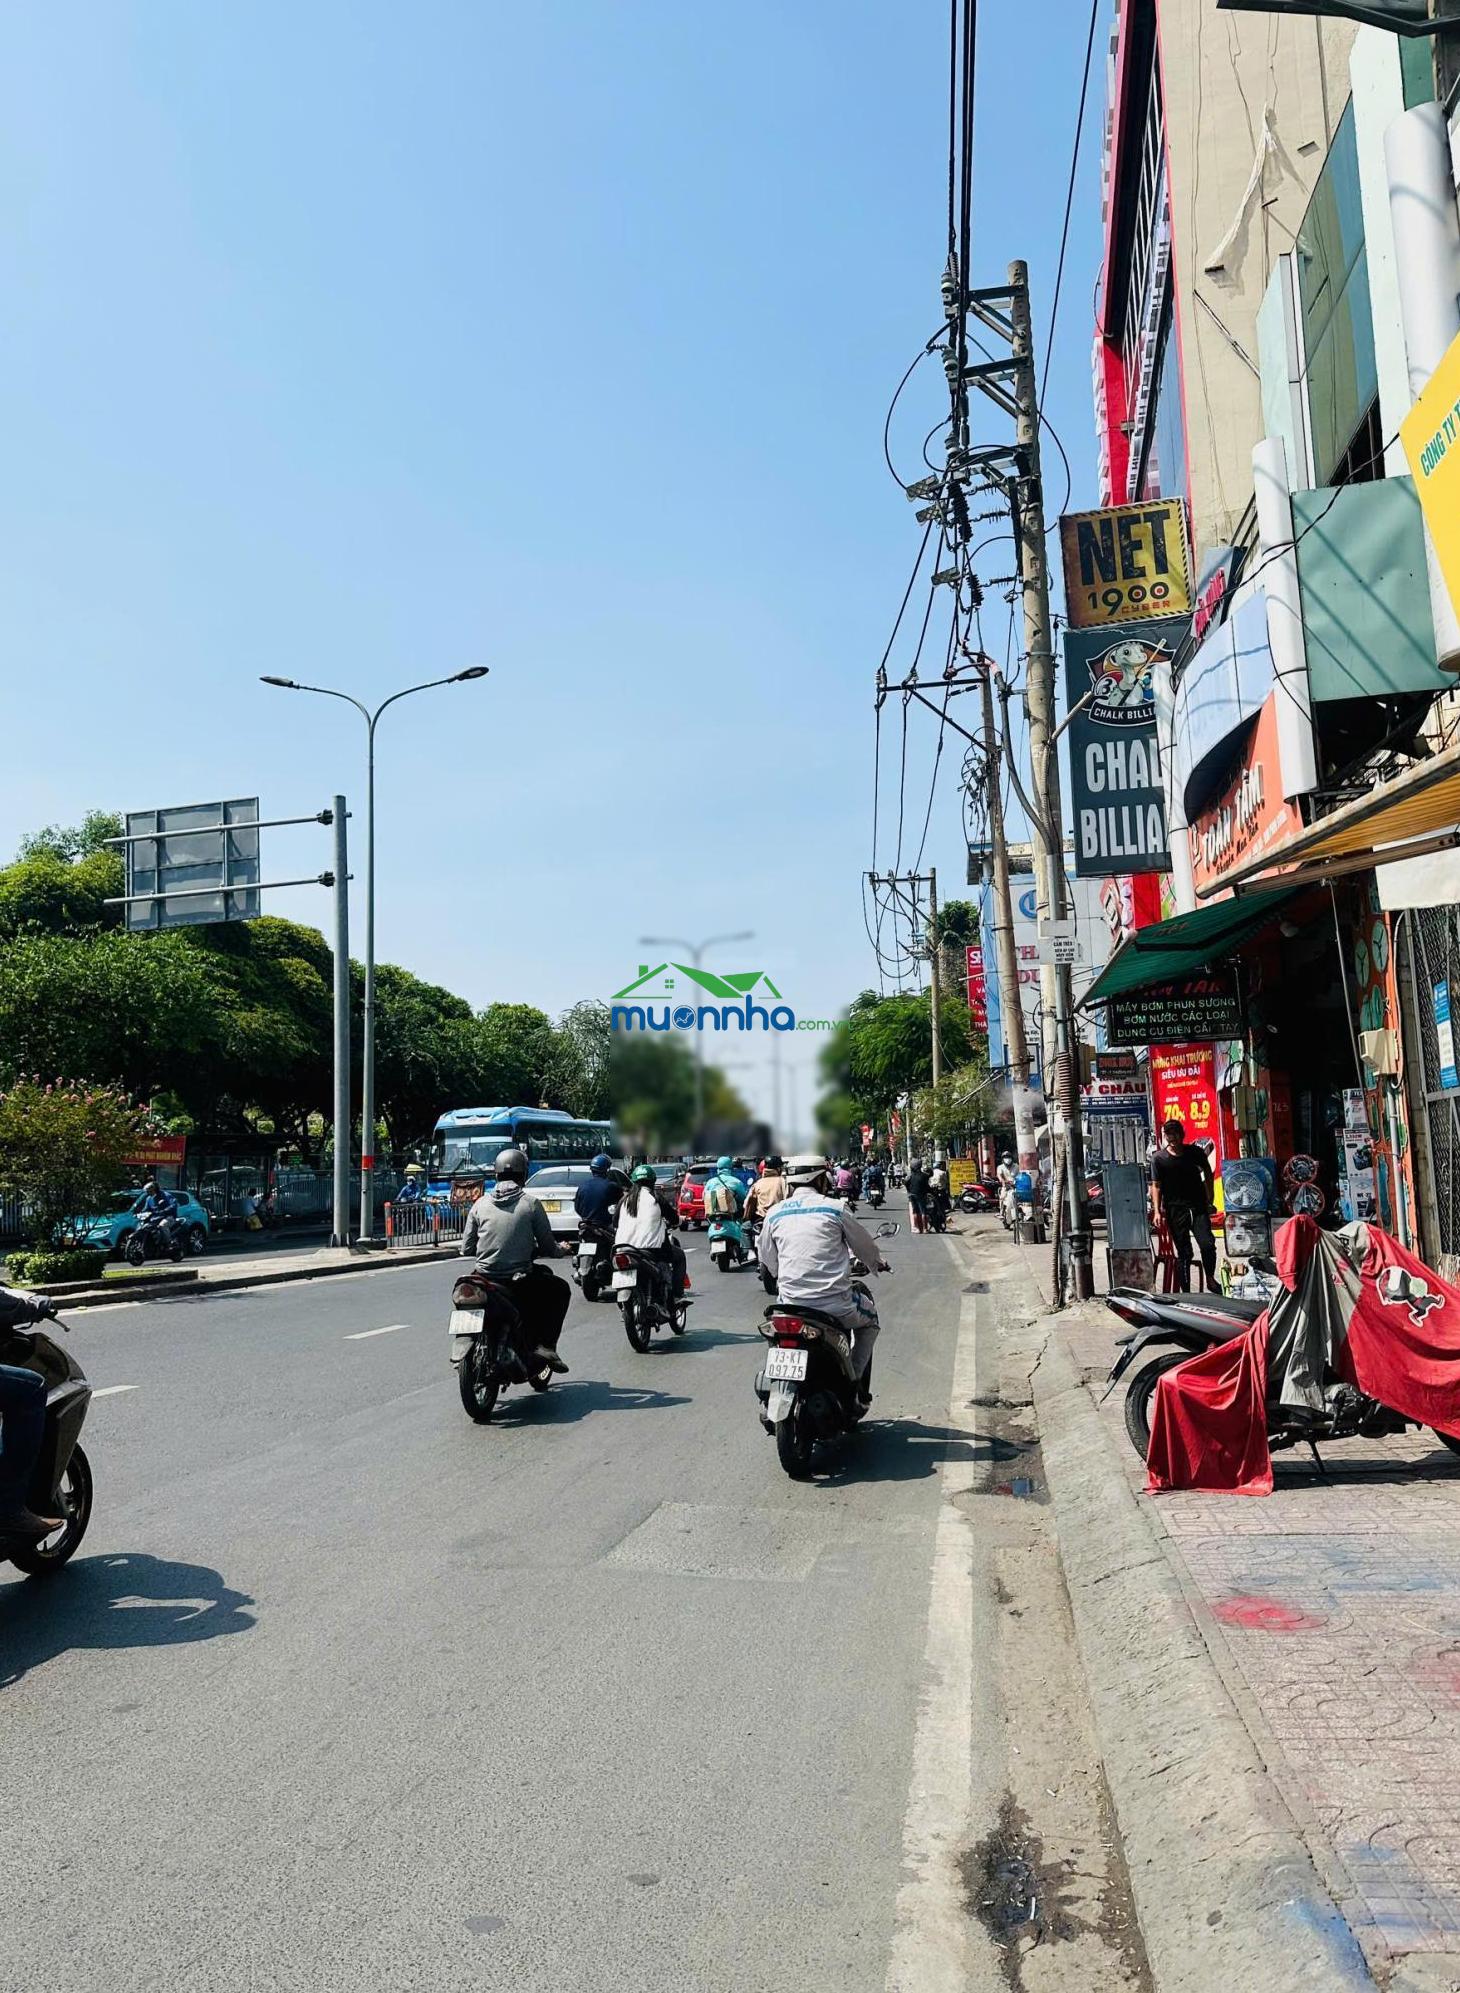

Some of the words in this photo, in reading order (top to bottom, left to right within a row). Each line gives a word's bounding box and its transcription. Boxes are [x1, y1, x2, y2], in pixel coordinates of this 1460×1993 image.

[1420, 431, 1446, 477] CÔNG
[1442, 413, 1457, 444] TY
[1077, 508, 1170, 585] NET
[1087, 582, 1169, 616] 1900
[1121, 600, 1170, 614] CYBER
[1094, 707, 1125, 720] CHALK
[1080, 802, 1167, 859] BILLIA
[769, 1364, 804, 1379] 097.75
